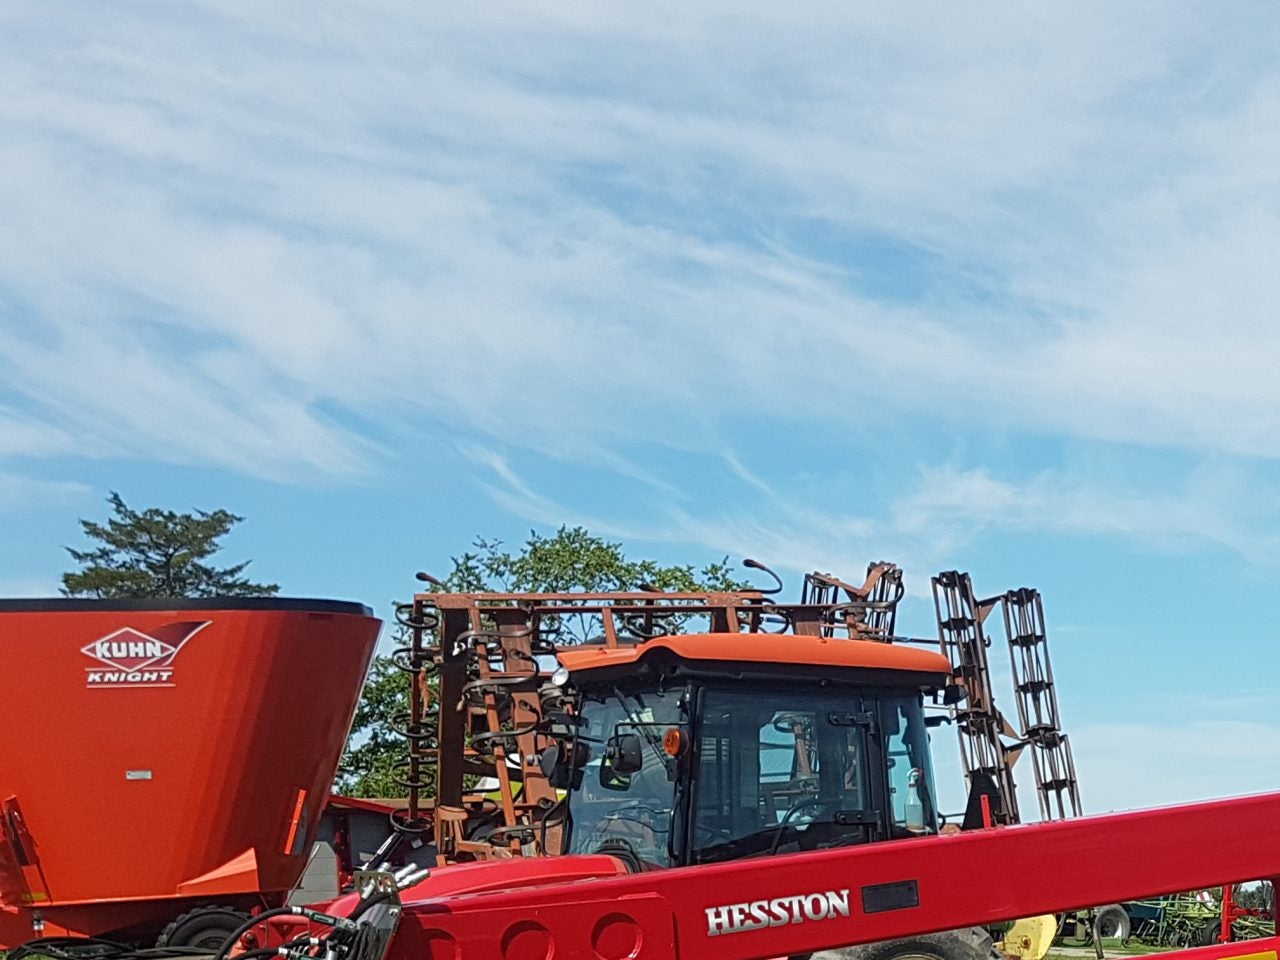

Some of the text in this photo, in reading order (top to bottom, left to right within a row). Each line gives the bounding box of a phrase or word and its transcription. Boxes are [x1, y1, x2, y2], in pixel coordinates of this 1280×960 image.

[95, 641, 162, 658] KUHN
[87, 671, 173, 683] KNIGHT
[704, 889, 850, 937] HESSTON
